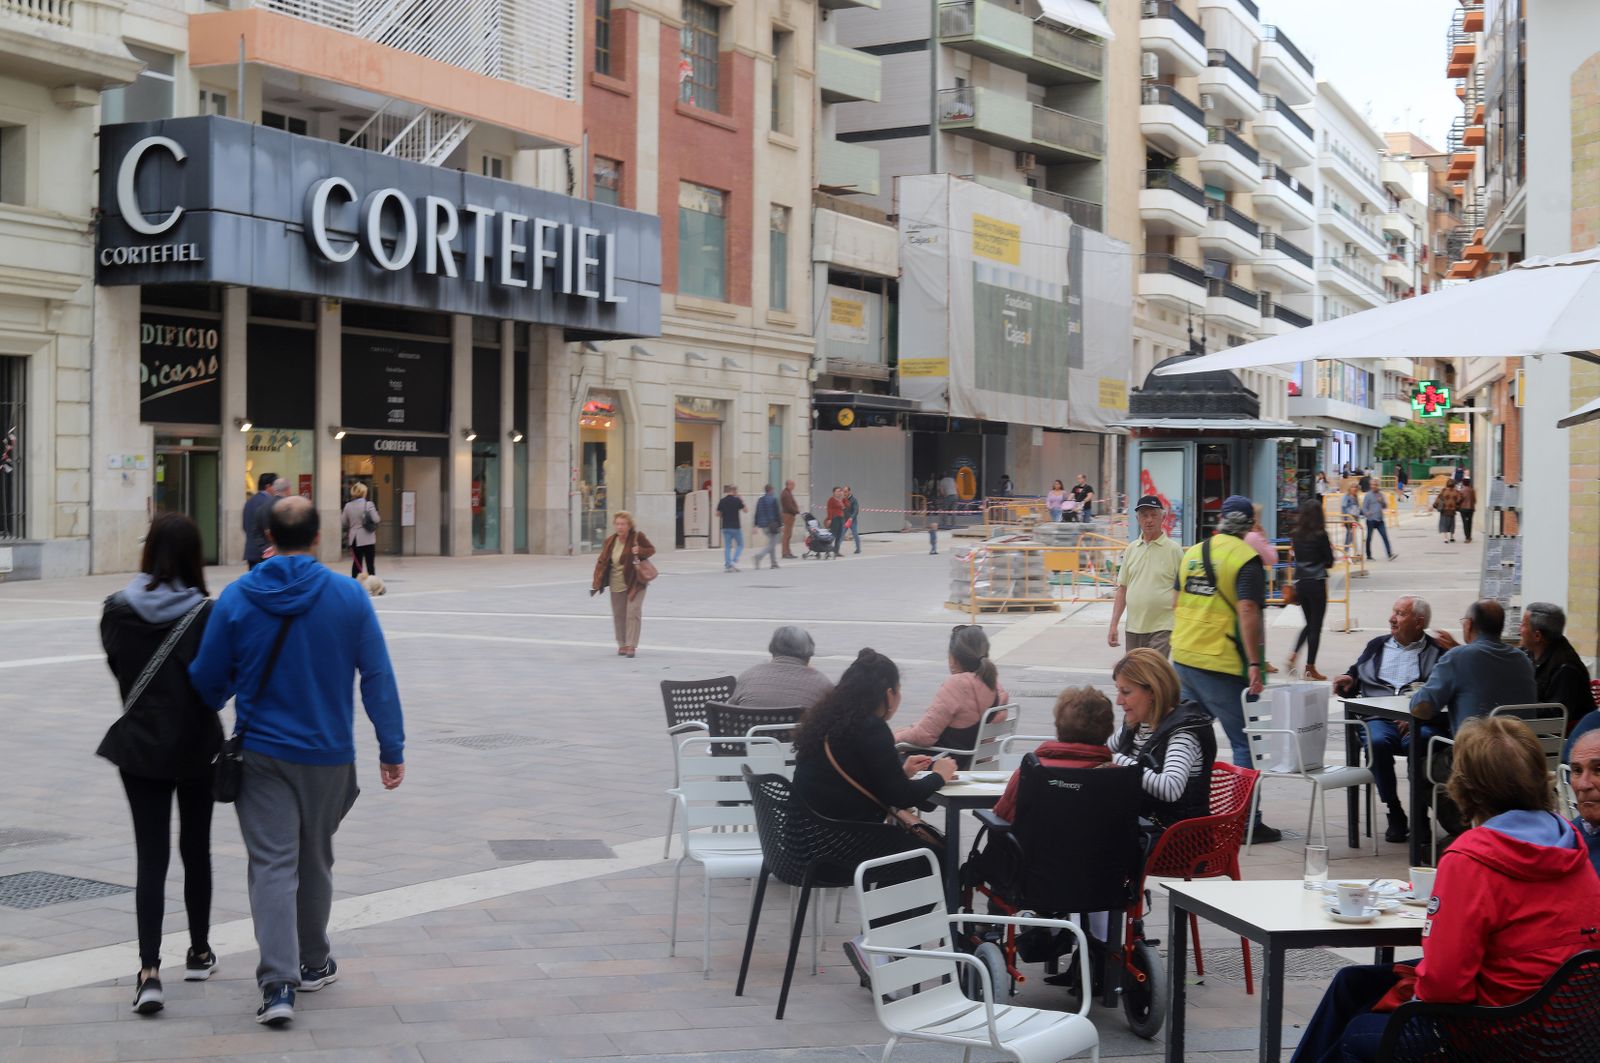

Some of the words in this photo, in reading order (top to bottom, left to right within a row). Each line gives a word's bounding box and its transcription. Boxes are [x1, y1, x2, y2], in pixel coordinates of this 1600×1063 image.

[117, 135, 188, 235] C
[310, 176, 628, 304] CORTEFIEL
[100, 243, 204, 266] CORTEFIEL
[141, 323, 218, 350] DIFICIO
[374, 439, 419, 452] CORTEFIEL
